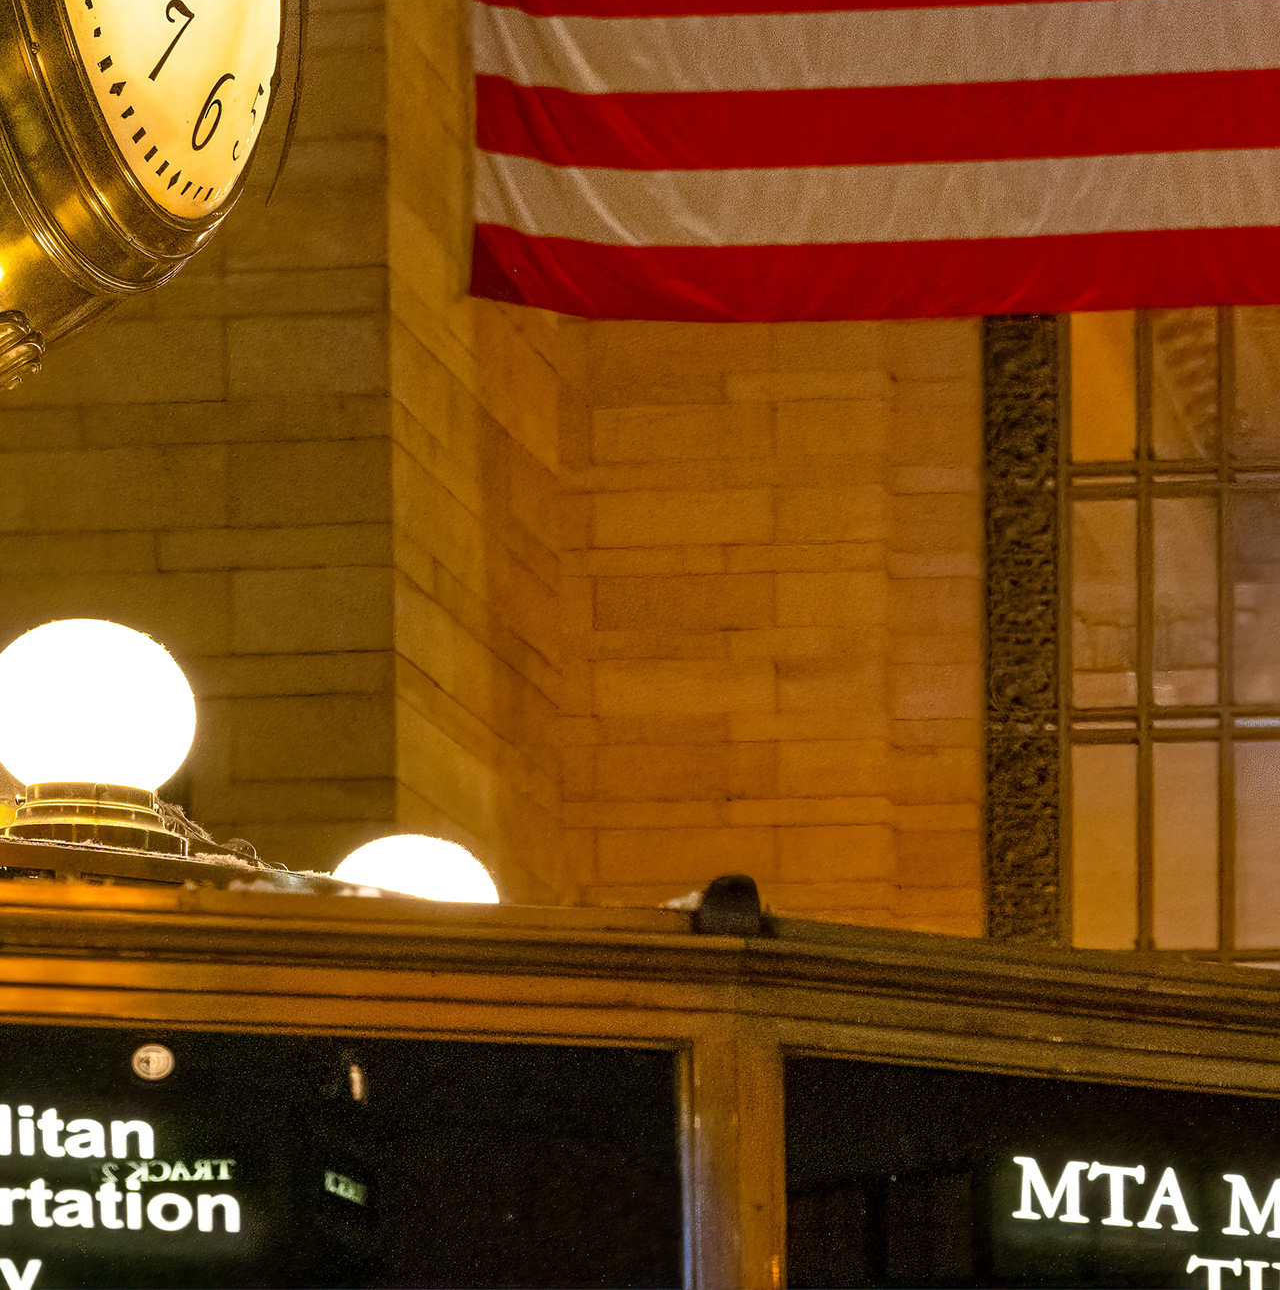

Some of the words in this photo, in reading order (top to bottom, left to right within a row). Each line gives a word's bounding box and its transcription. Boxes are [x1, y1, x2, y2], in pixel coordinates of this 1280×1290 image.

[149, 0, 194, 81] 7
[192, 73, 236, 151] 6
[1013, 1157, 1198, 1231] MTA
